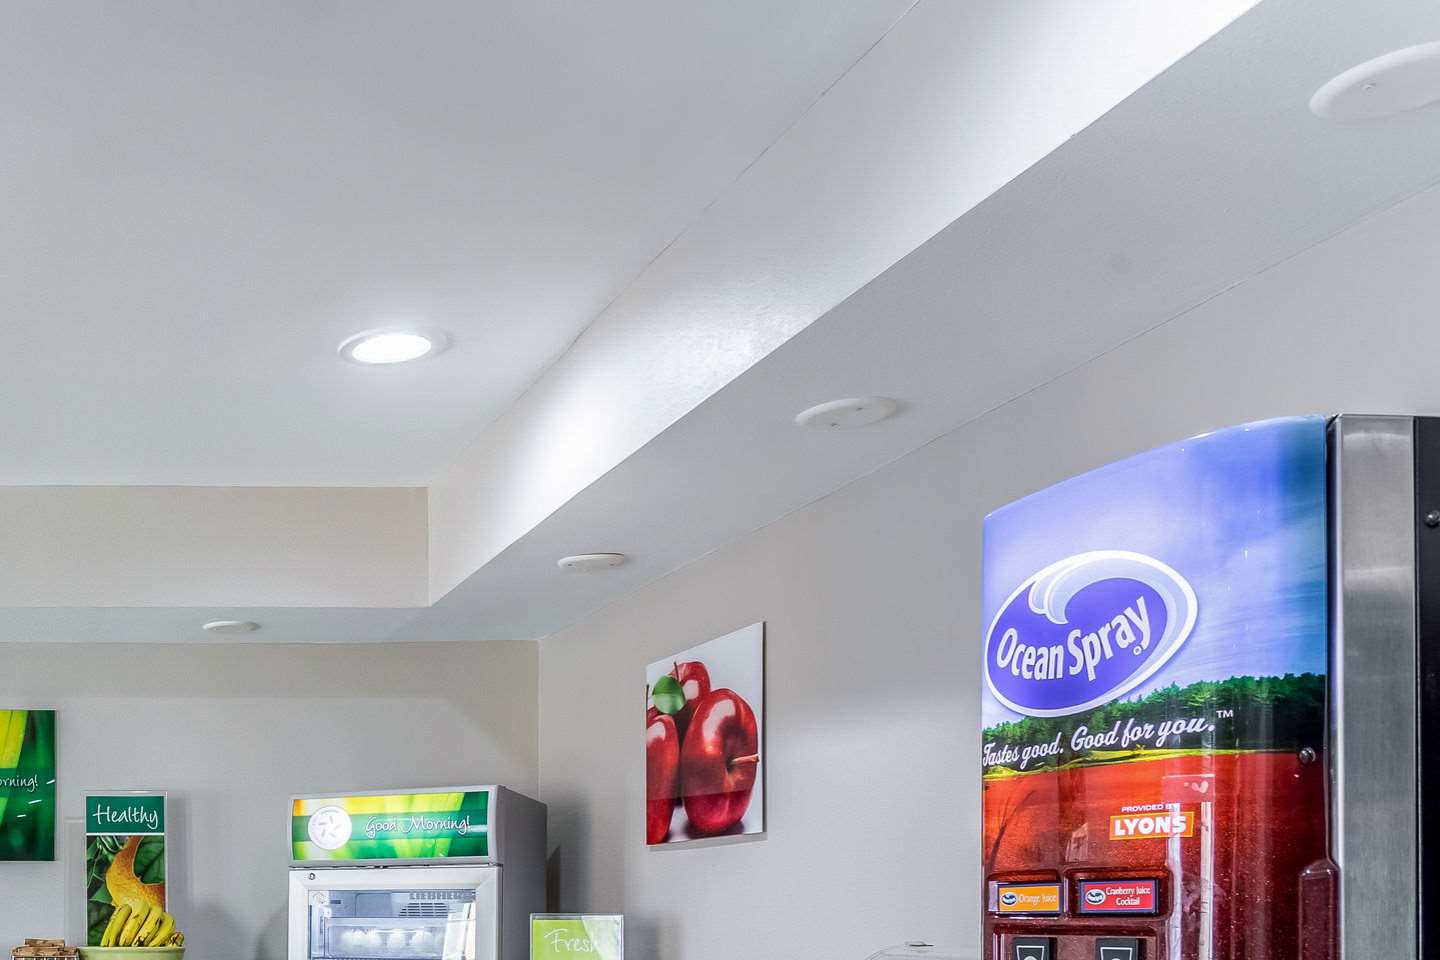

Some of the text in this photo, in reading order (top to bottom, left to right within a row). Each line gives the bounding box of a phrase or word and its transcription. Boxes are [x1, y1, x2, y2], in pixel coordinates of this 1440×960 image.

[996, 596, 1151, 682] Ocean Spray
[983, 742, 1020, 767] Tastes
[1021, 732, 1064, 770] good.
[1071, 718, 1121, 751] Good
[1121, 717, 1155, 748] for
[1156, 717, 1216, 748] you.
[92, 803, 159, 830] Healthy
[1121, 803, 1164, 813] PROVIDED
[366, 815, 472, 839] Good Morning!
[1114, 816, 1187, 836] LYONS
[1105, 886, 1135, 897] Cranberry
[1136, 885, 1151, 895] Juice
[1116, 897, 1140, 906] Cocktail
